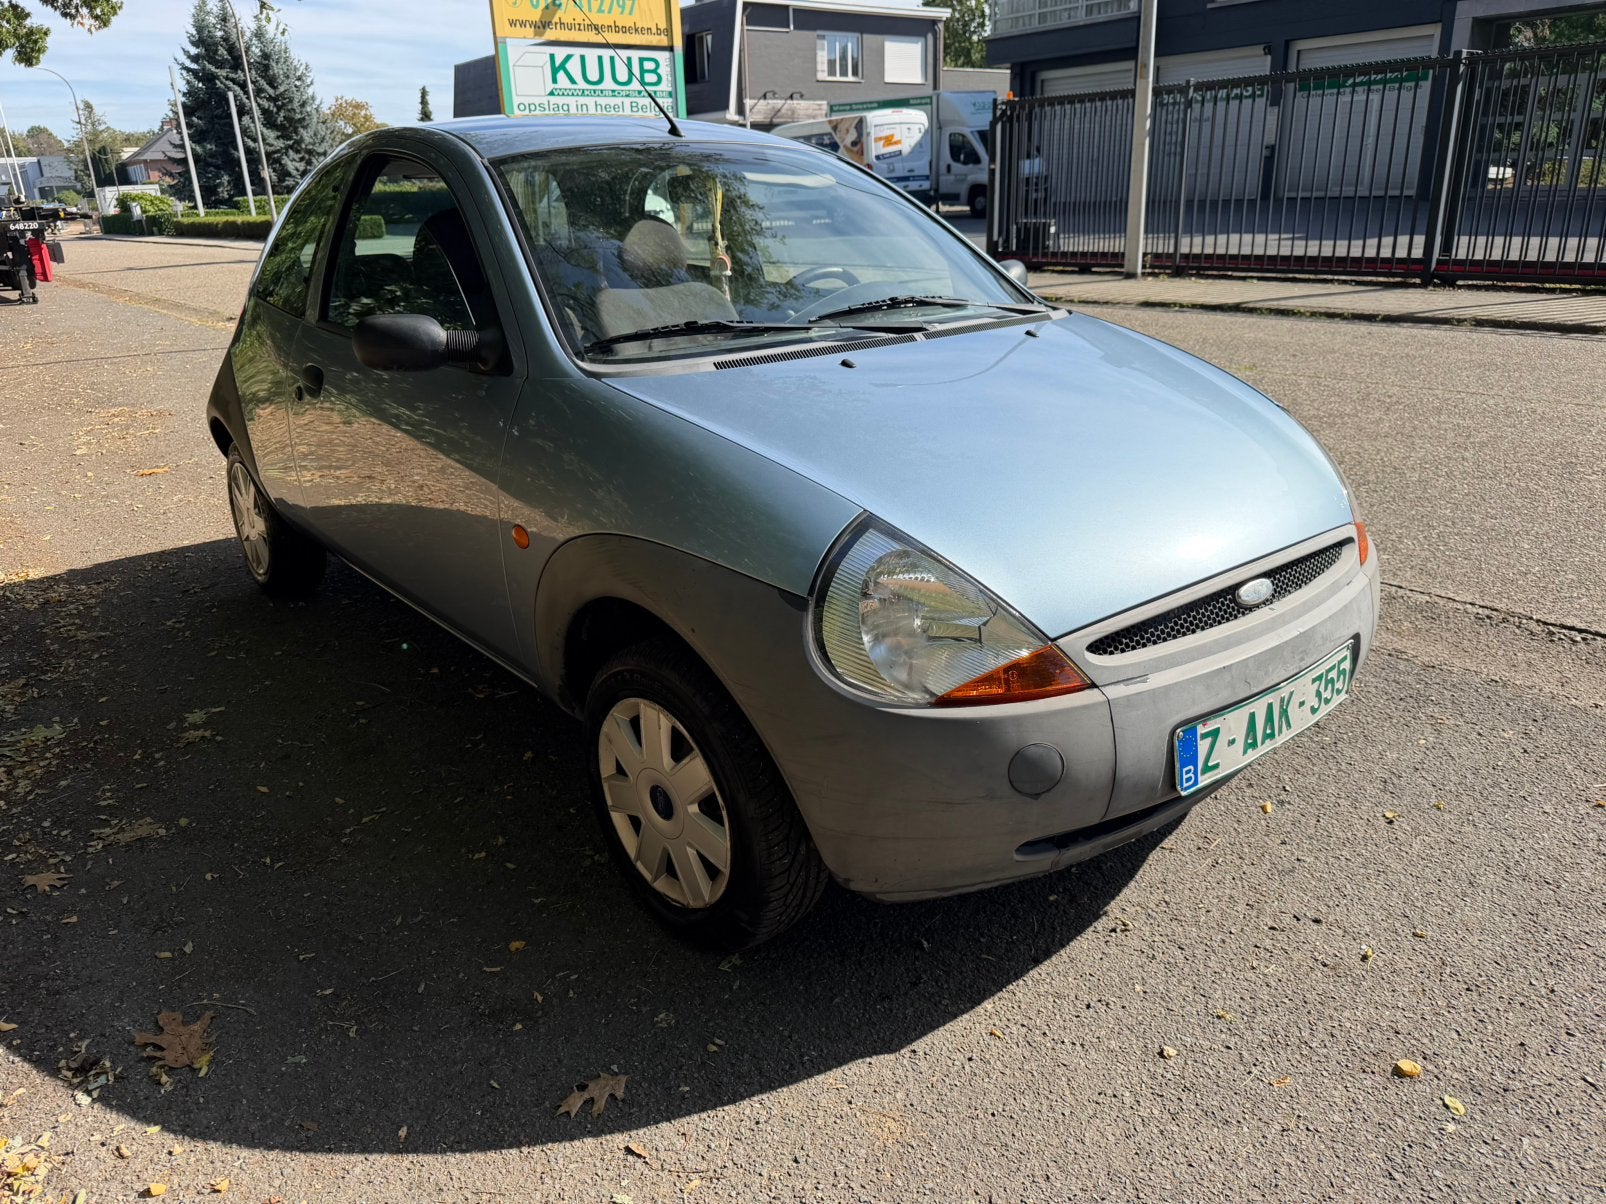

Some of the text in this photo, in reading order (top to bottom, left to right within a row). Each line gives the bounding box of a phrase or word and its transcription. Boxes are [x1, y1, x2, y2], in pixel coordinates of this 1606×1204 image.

[508, 17, 669, 36] www.verhuizingenbaeken.be
[549, 53, 662, 87] KUUB
[575, 100, 589, 113] in
[594, 100, 625, 113] heel
[9, 222, 39, 230] 648220
[1200, 655, 1348, 776] Z-AAK-355
[1182, 765, 1195, 787] B
